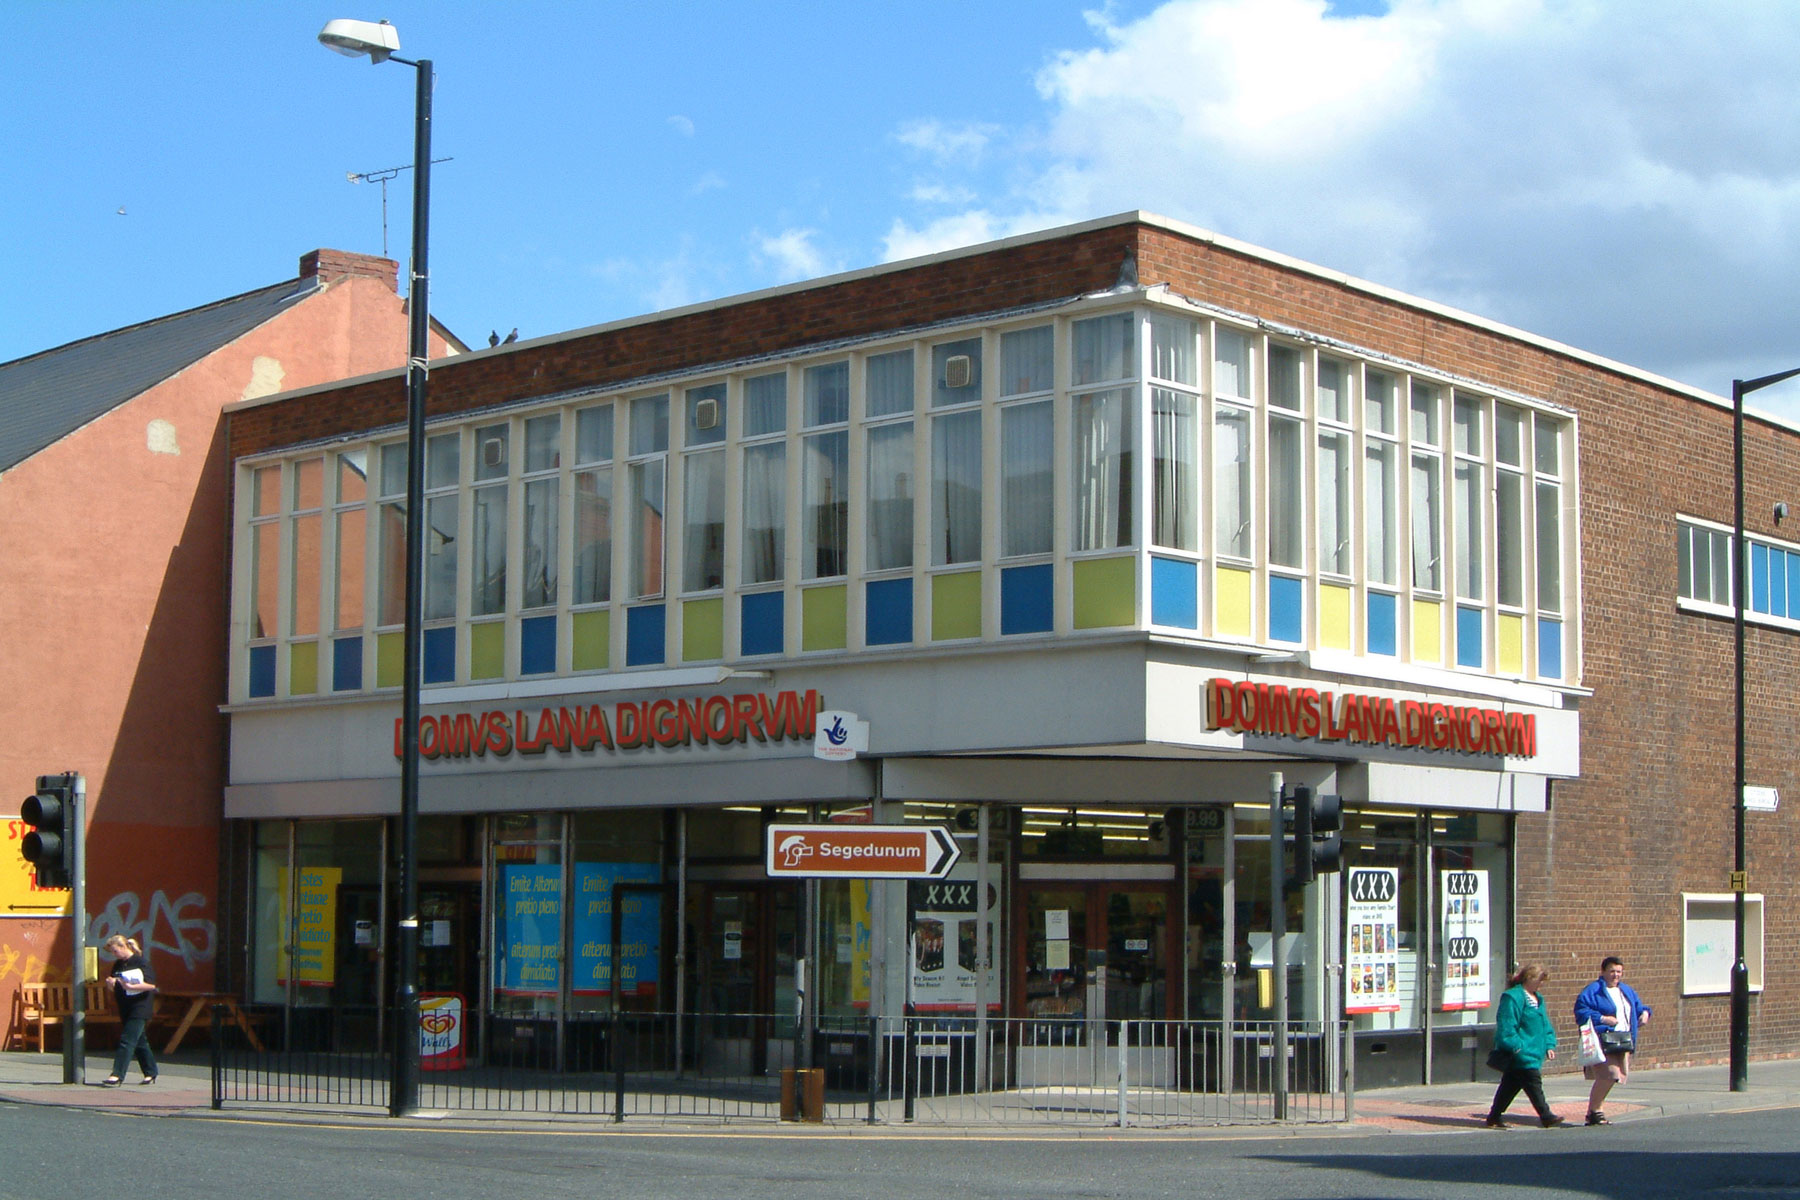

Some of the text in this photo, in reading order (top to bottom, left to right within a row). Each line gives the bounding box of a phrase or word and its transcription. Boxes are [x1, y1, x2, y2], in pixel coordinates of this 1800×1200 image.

[516, 704, 614, 752] LANA
[616, 688, 818, 746] DIGNORVM
[1214, 677, 1538, 757] DOMVS LANA DIGNORVM
[819, 842, 921, 860] Segedunum
[1355, 873, 1391, 900] XXX
[1450, 874, 1475, 894] XXX
[588, 897, 612, 917] preti
[1451, 939, 1475, 957] XXX
